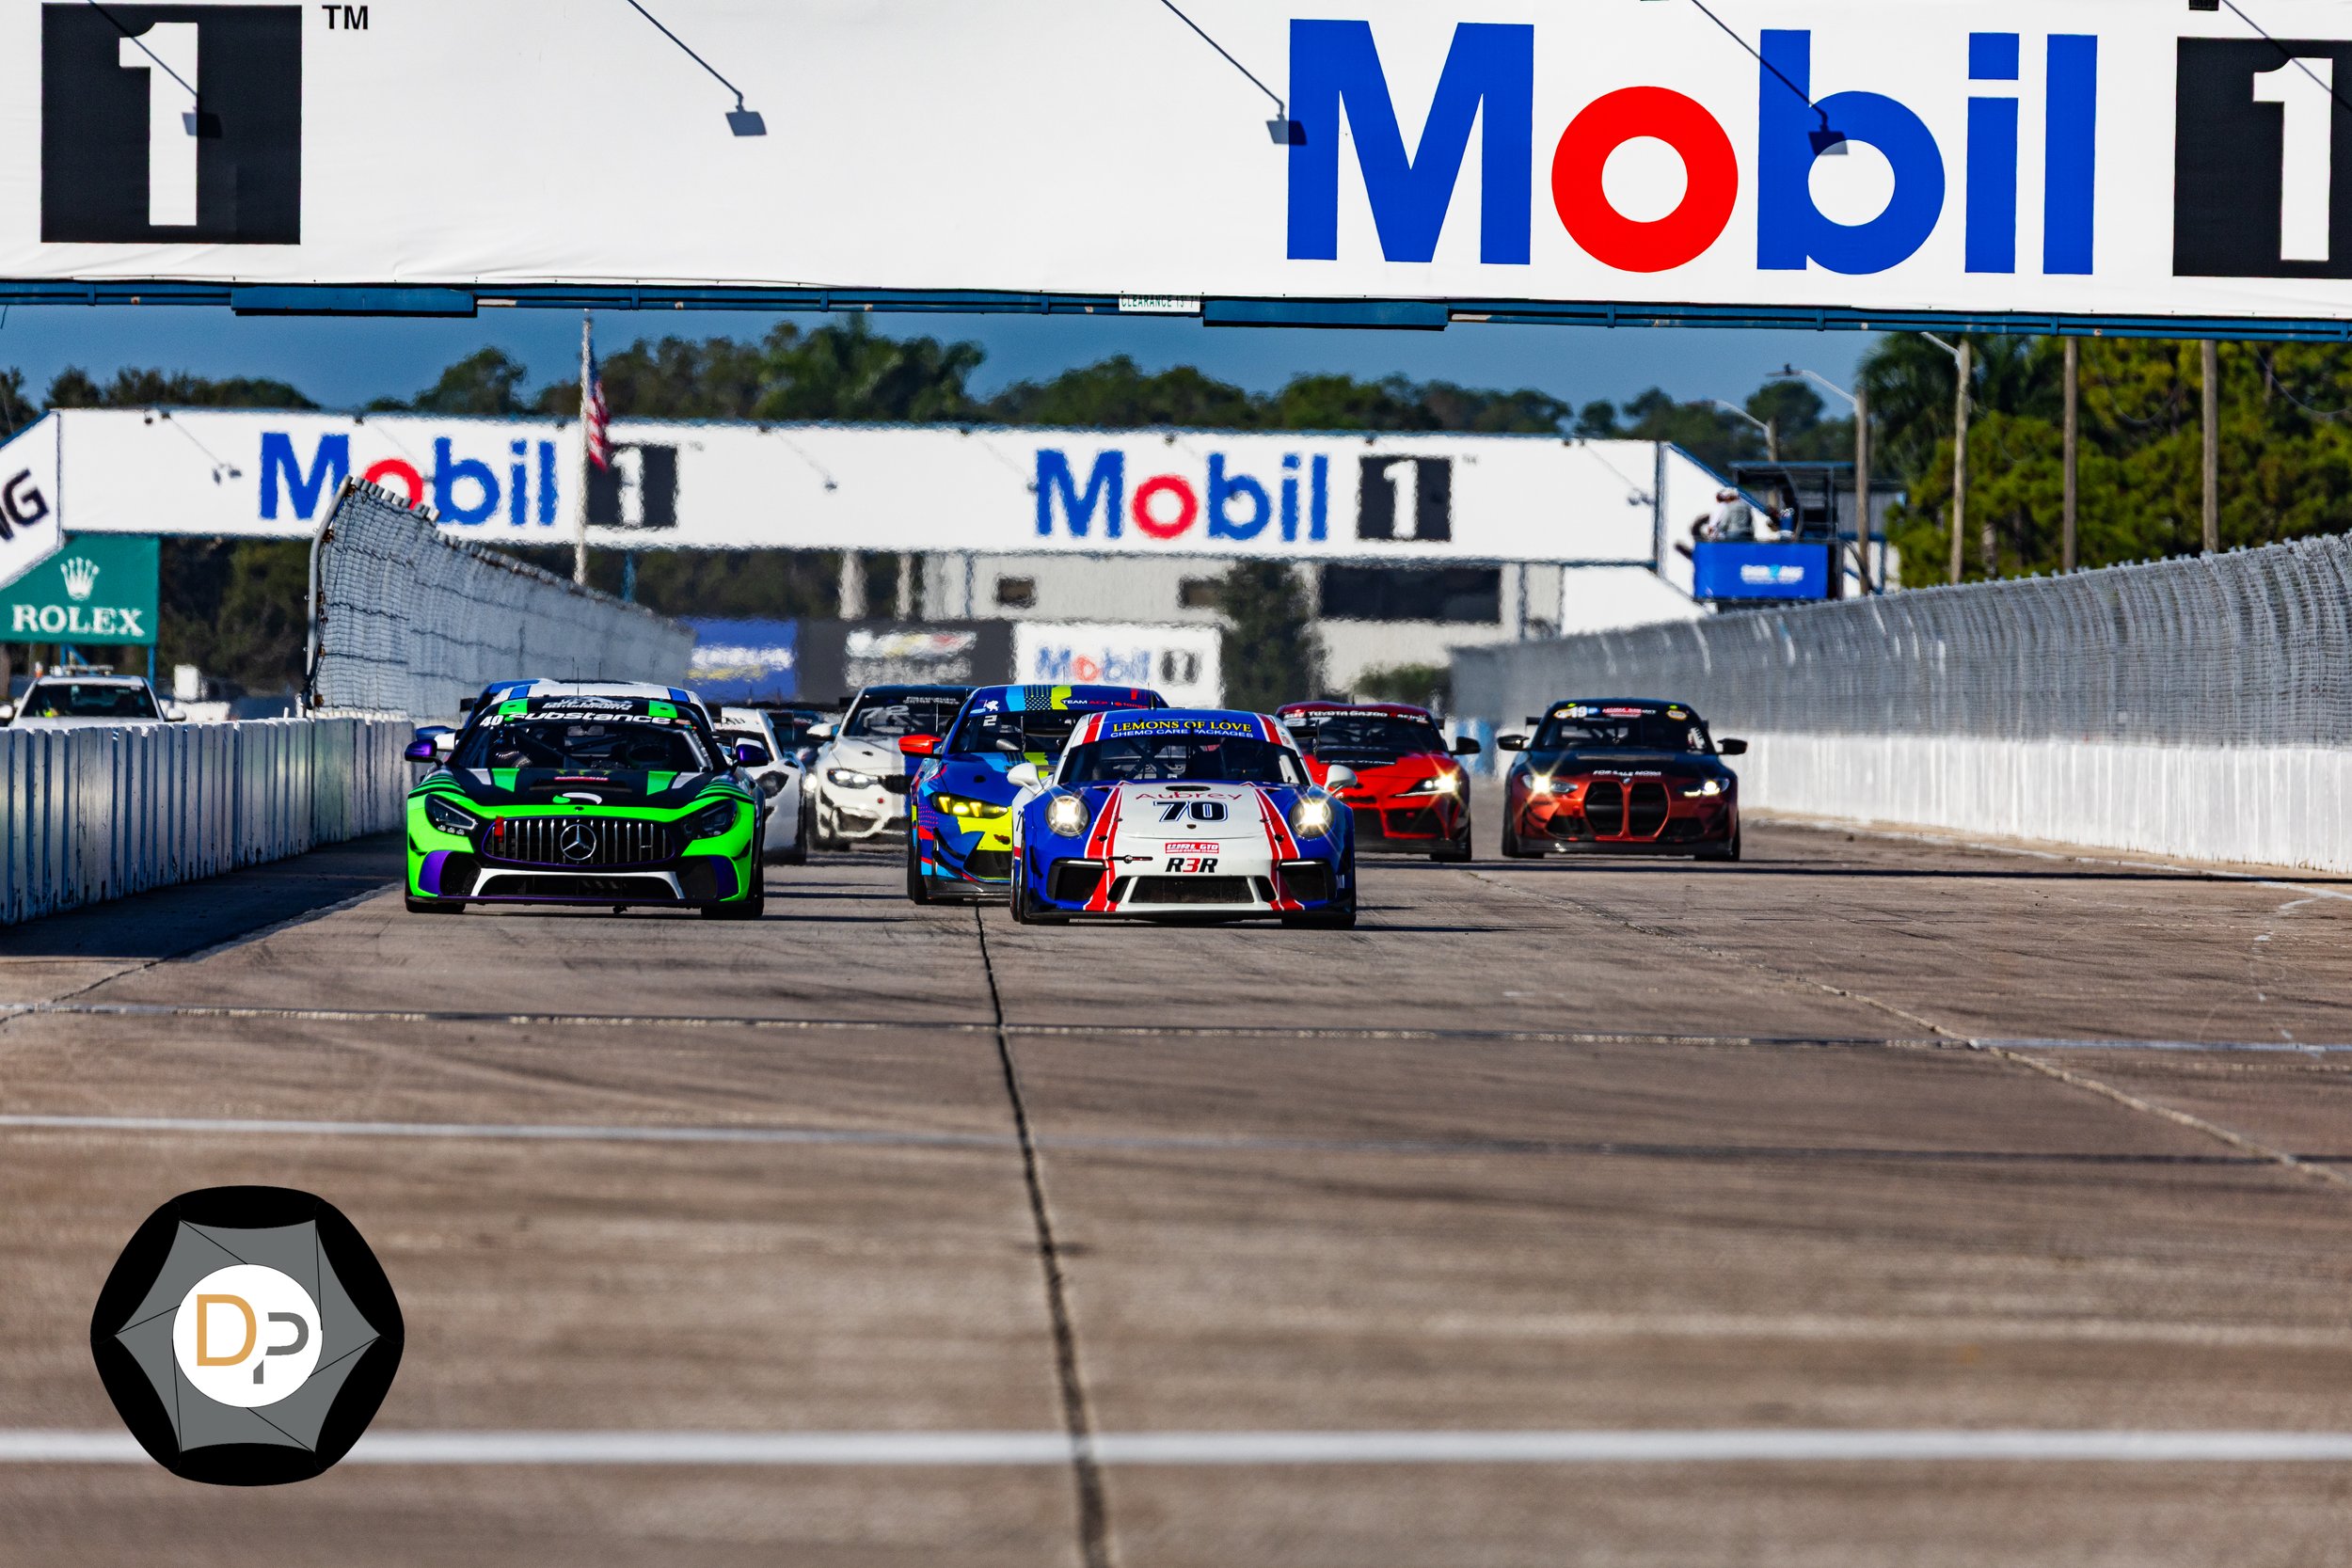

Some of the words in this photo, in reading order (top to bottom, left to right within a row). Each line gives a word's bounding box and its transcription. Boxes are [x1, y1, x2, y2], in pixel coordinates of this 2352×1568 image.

[119, 23, 199, 227] 1
[321, 5, 369, 30] TM
[1287, 18, 2098, 276] Mobil
[2252, 56, 2333, 261] 1
[1120, 294, 1172, 308] CLEARANCE
[259, 432, 558, 527] Mobil
[608, 445, 645, 528] 1
[1036, 448, 1328, 542] Mobil
[1383, 459, 1419, 539] 1
[12, 604, 146, 638] ROLEX
[1036, 645, 1151, 683] Mobil
[479, 715, 504, 727] 40
[982, 715, 998, 727] 2
[1569, 706, 1588, 719] 19
[1110, 729, 1153, 737] CHEMO
[1194, 729, 1254, 737] PACKAGES
[1113, 721, 1180, 732] LEMONS
[1184, 721, 1205, 729] OF
[1210, 721, 1252, 732] LOVE
[1136, 791, 1242, 800] Aubrey
[1153, 800, 1229, 822] 70
[1165, 857, 1219, 874] R3R
